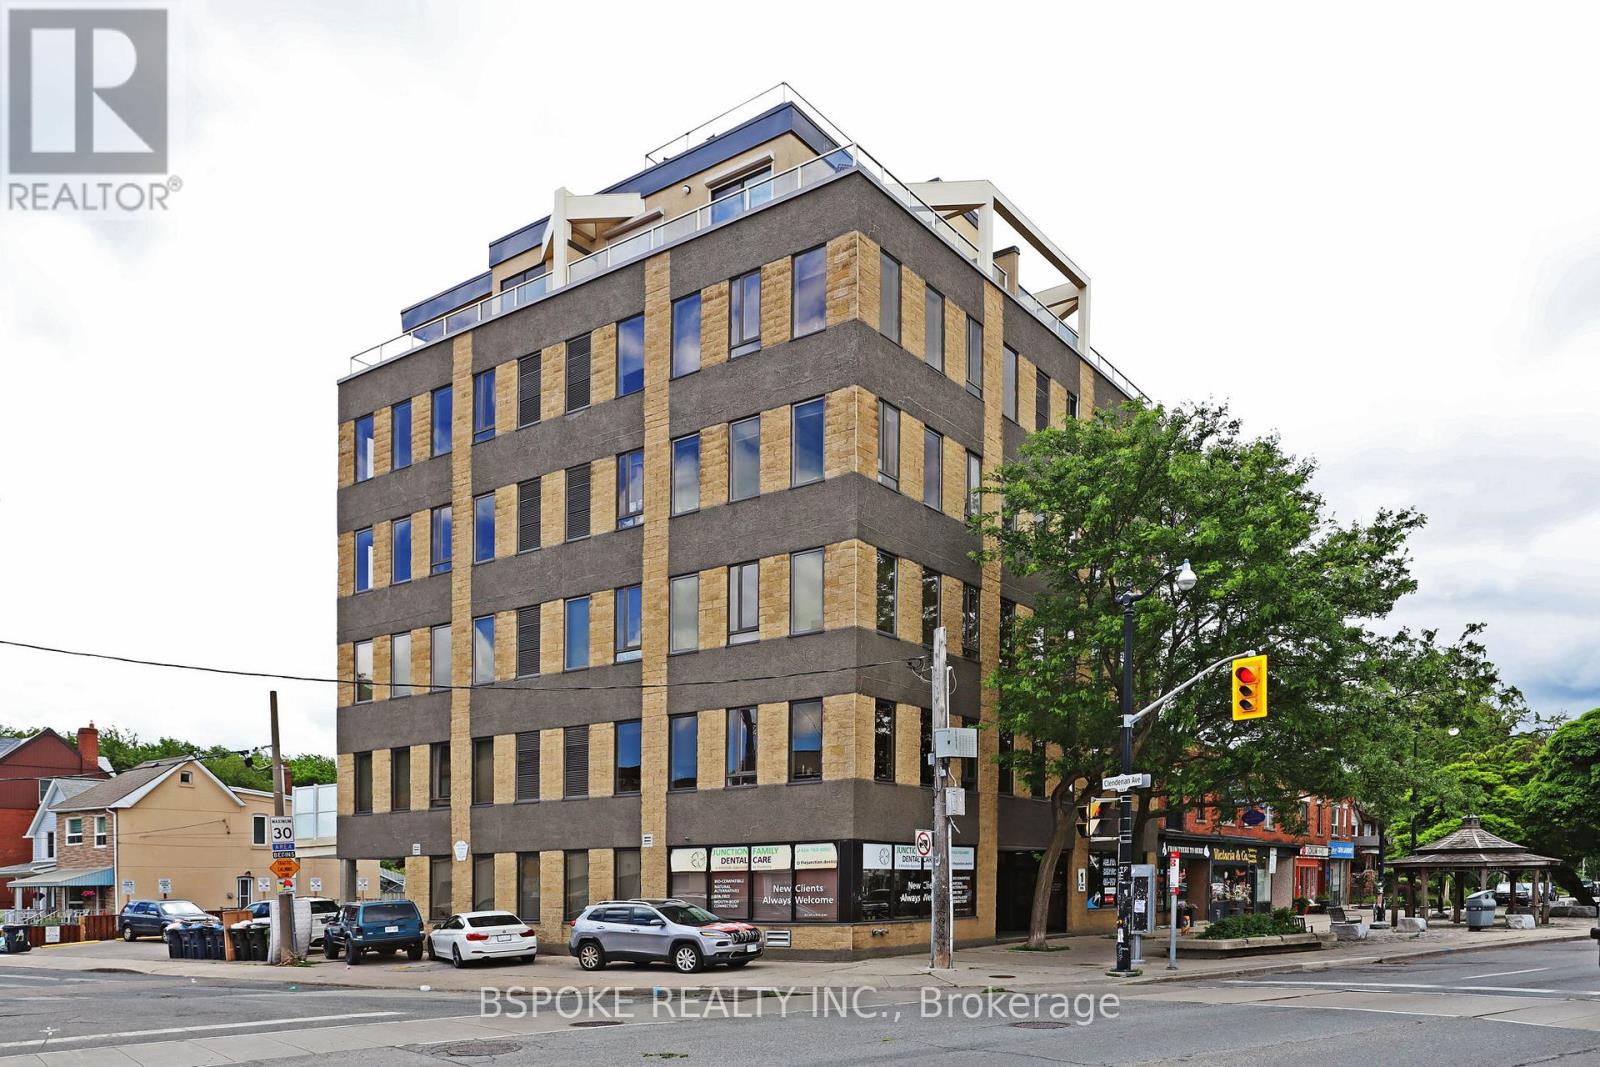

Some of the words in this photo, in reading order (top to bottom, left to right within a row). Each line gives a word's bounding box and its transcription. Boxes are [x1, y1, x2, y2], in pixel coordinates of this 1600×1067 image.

[1103, 779, 1131, 787] Clendenan
[1131, 776, 1142, 784] Ave
[273, 827, 292, 839] 30
[713, 847, 748, 857] JUNCTION
[752, 847, 779, 855] FAMILY
[1214, 848, 1235, 860] Victoria
[1236, 849, 1241, 860] &
[720, 857, 748, 865] DENTAL
[752, 856, 772, 864] CARE
[773, 885, 791, 893] New
[795, 884, 824, 892] Clients
[908, 881, 921, 890] New
[762, 896, 791, 905] Always
[794, 896, 834, 904] Welcome
[900, 893, 921, 903] Always
